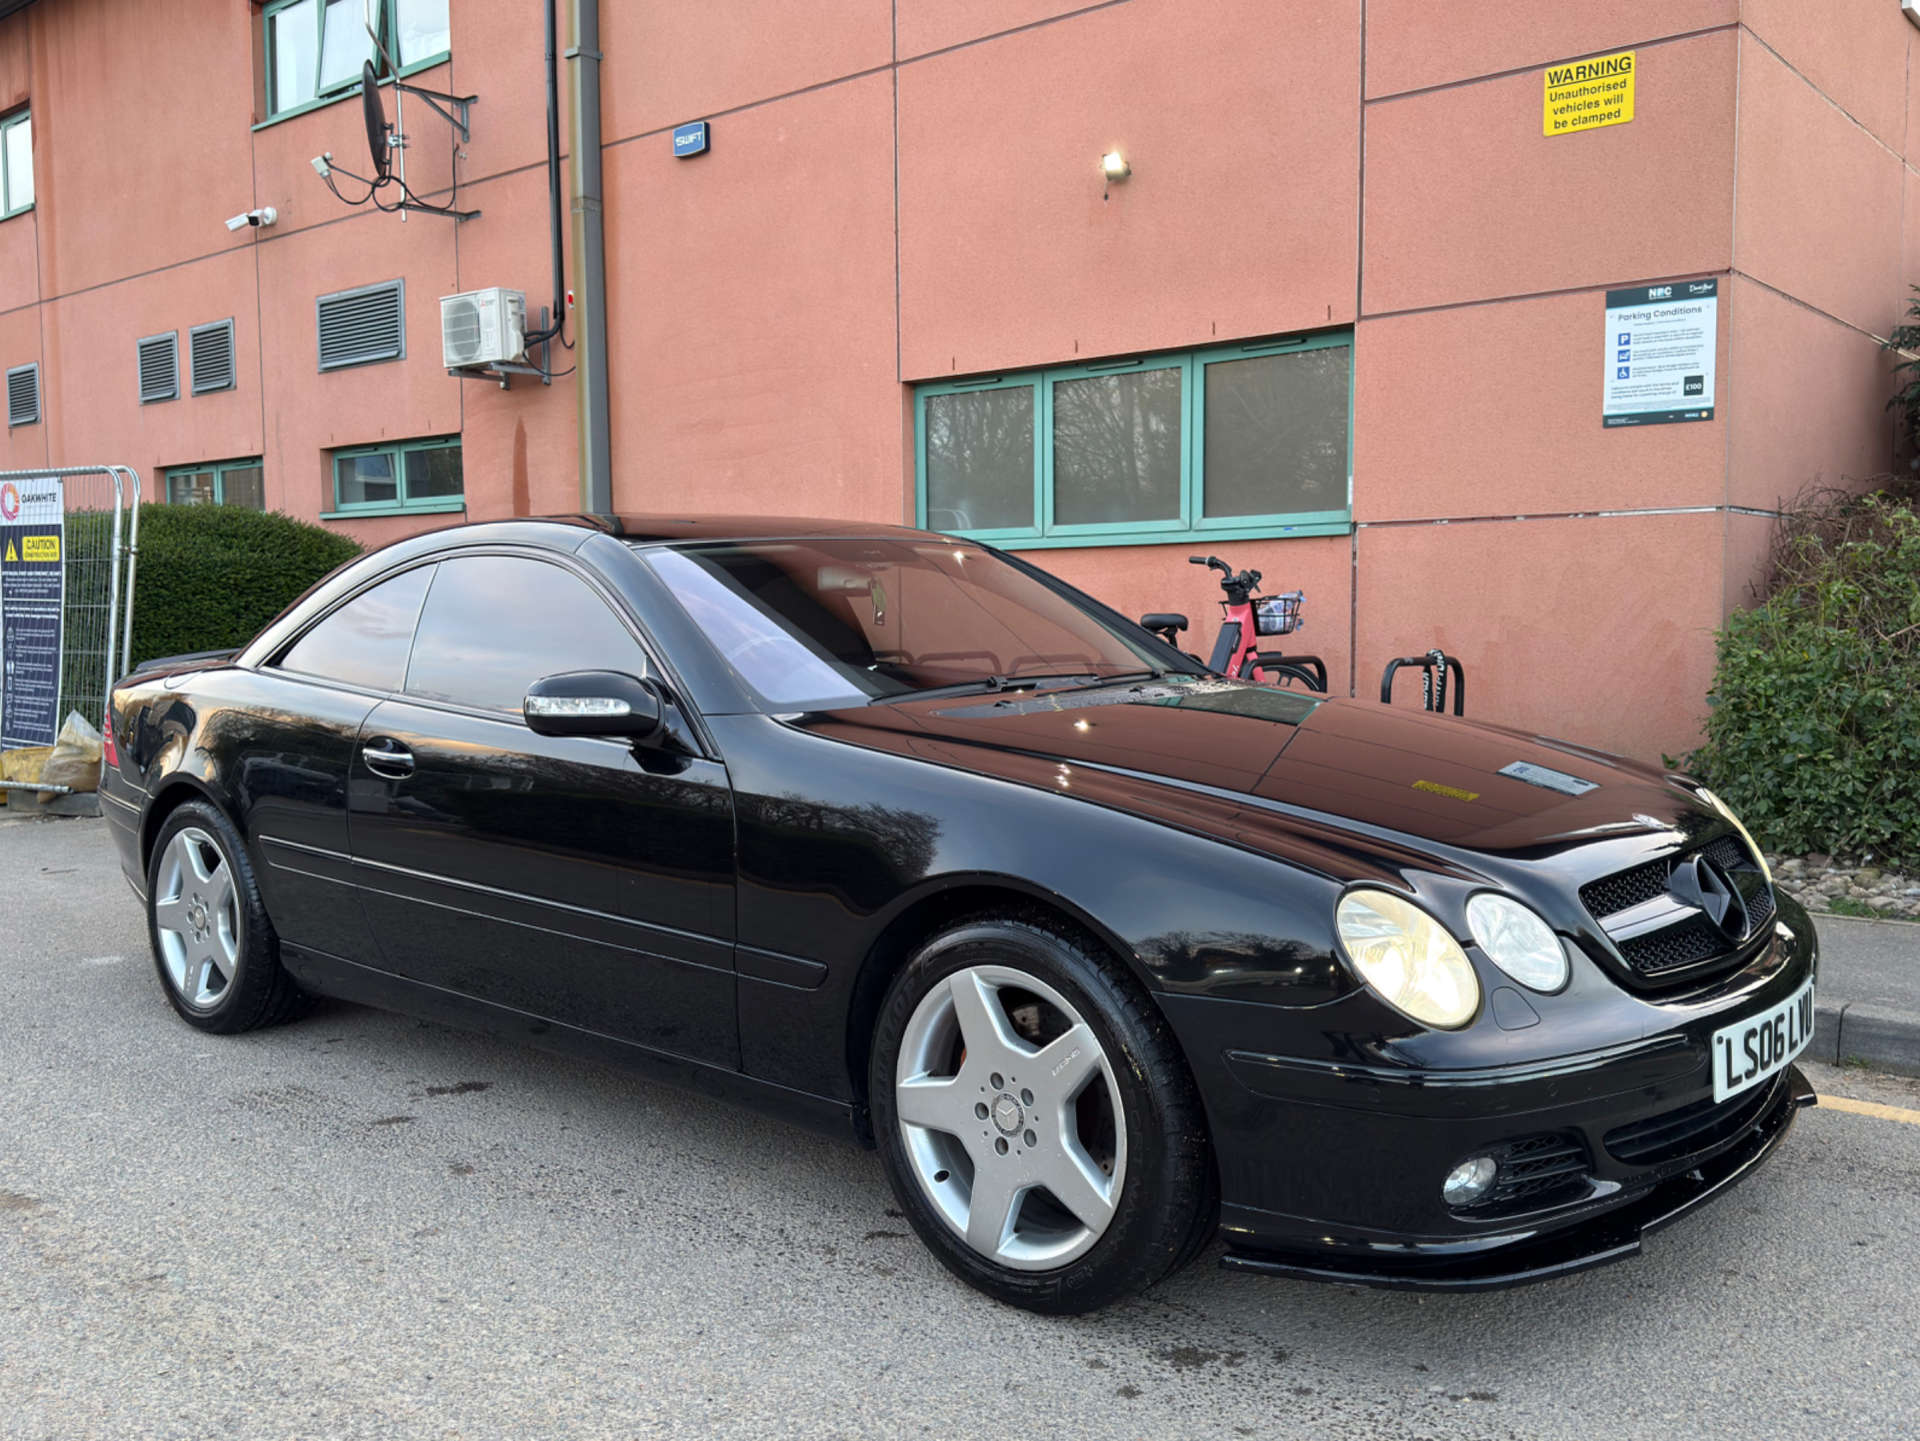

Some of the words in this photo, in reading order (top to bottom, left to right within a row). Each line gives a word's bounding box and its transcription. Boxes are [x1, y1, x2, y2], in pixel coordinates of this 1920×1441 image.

[1548, 56, 1632, 85] WARNING
[1549, 78, 1627, 102] Unauthorised
[1553, 100, 1600, 115] vehicles
[1604, 93, 1624, 106] will
[1554, 119, 1568, 129] be
[1571, 108, 1621, 126] clamped
[1618, 310, 1652, 322] Parking
[1653, 306, 1703, 318] Conditions
[21, 492, 57, 504] OAKWHITE
[1725, 1013, 1785, 1089] LS06
